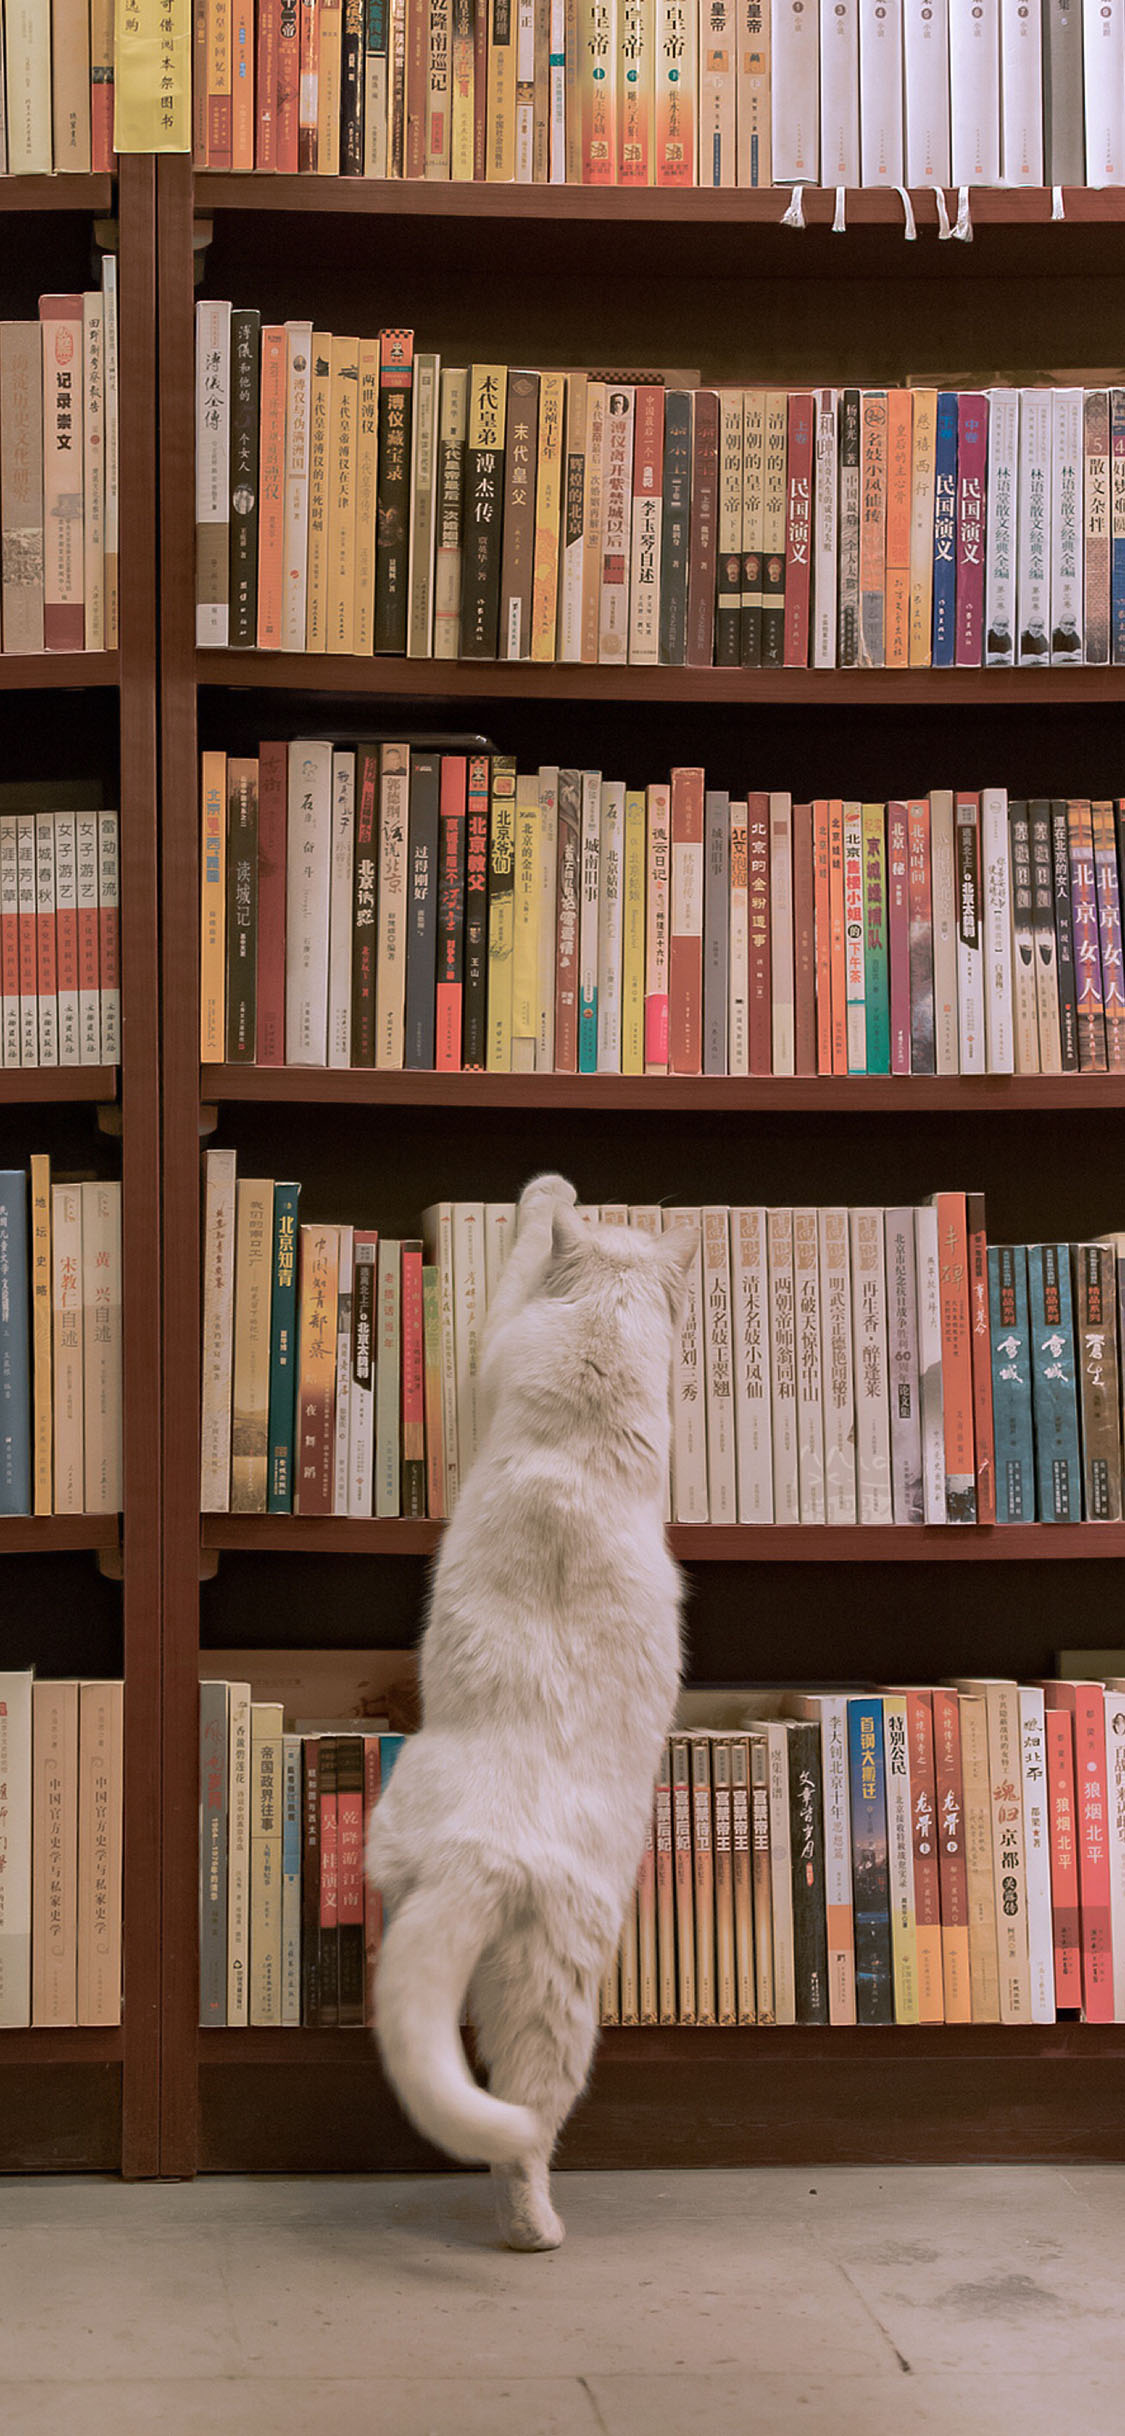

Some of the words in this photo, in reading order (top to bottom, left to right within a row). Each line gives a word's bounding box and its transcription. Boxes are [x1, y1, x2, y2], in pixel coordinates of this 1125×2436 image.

[587, 5, 610, 56] 皇帝
[622, 7, 644, 59] 皇帝
[663, 7, 686, 59] 皇帝
[710, 1, 726, 32] 皇帝
[746, 3, 762, 34] 皇帝
[56, 372, 72, 451] 记录崇文
[292, 377, 306, 471] 溥仪与伪满洲国
[361, 373, 376, 435] 两世溥仪
[386, 394, 406, 481] 溥仪藏宝录
[476, 375, 498, 446] 末代皇弟
[543, 398, 557, 460] 崇祯十七年
[1093, 436, 1103, 453] 5
[238, 432, 251, 472] 个女人
[312, 391, 326, 532] 末代皇帝溥仪的生死时刻
[337, 394, 350, 509] 末代皇帝溥仪在天津
[512, 422, 529, 507] 末代皇父
[606, 419, 626, 548] 溥仪离开紫禁城以后
[724, 411, 741, 513] 清朝的皇帝
[745, 411, 761, 513] 清朝的皇帝
[766, 411, 783, 513] 清朝的皇帝
[864, 432, 883, 522] 名妓小凤仙传
[915, 415, 929, 497] 慈禧西行
[1115, 438, 1124, 455] 4
[474, 453, 495, 523] 溥杰传
[567, 458, 584, 535] 辉煌的北京
[789, 477, 809, 566] 民国演义
[935, 474, 955, 562] 民国演义
[960, 477, 981, 566] 民国演义
[995, 467, 1011, 580] 林语堂散文经典全编
[1029, 468, 1044, 580] 林语堂散文经典全编
[1060, 466, 1076, 578] 林语堂散文经典全编
[1089, 459, 1105, 533] 散文杂拌
[638, 499, 657, 585] 李玉琴自述
[1, 826, 16, 902] 天涯芳草
[19, 826, 34, 902] 天涯芳草
[38, 825, 53, 903] 皇城春秋
[58, 823, 73, 899] 女子游艺
[79, 822, 95, 898] 女子游艺
[303, 840, 315, 879] 奋斗
[414, 846, 429, 901] 过得刚好
[467, 817, 487, 892] 北京教父
[493, 809, 512, 874] 北京爷们
[521, 823, 534, 893] 北京的金山上
[583, 838, 600, 902] 城南旧事
[606, 850, 618, 900] 北京姑娘
[732, 828, 747, 887] 北京泡泡
[910, 824, 925, 885] 北京时间
[235, 860, 252, 928] 读城记
[356, 859, 375, 927] 北京诱惑
[751, 822, 767, 947] 北京的金粉遗事
[1073, 863, 1100, 1002] 北京女人
[1097, 864, 1125, 1004] 北京女人
[35, 1197, 47, 1297] 地坛史略
[278, 1216, 294, 1287] 北京知青
[941, 1224, 964, 1290] 丰碑
[60, 1256, 78, 1348] 宋教仁自述
[94, 1251, 112, 1344] 黄兴自述
[308, 1238, 333, 1359] 中国知青部落
[709, 1277, 731, 1398] 大明名妓王翠翘
[742, 1275, 763, 1399] 清末名妓小凤仙
[774, 1276, 795, 1400] 两朝帝师翁同和
[800, 1280, 819, 1403] 石破天惊孙中山
[828, 1277, 847, 1409] 明武宗正德艳闻秘事
[862, 1280, 881, 1398] 再生香·醉蓬莱
[996, 1336, 1024, 1383] 雪城
[1041, 1333, 1069, 1383] 雪城
[829, 1716, 844, 1820] 李大钊北京十年
[860, 1717, 877, 1800] 首钢大搬迁
[890, 1716, 907, 1776] 特别公民
[260, 1747, 274, 1831] 帝国政界往事
[914, 1792, 932, 1838] 龙骨
[942, 1789, 960, 1836] 龙骨
[993, 1779, 1020, 1869] 魂归京都
[1083, 1782, 1103, 1865] 狼烟北平
[49, 1778, 61, 1937] 中国官方史学与私家史学
[95, 1777, 108, 1934] 中国官方史学与私家史学
[323, 1814, 337, 1908] 吴三桂演义
[342, 1811, 358, 1906] 乾隆游江南
[1055, 1798, 1072, 1870] 狼烟北平
